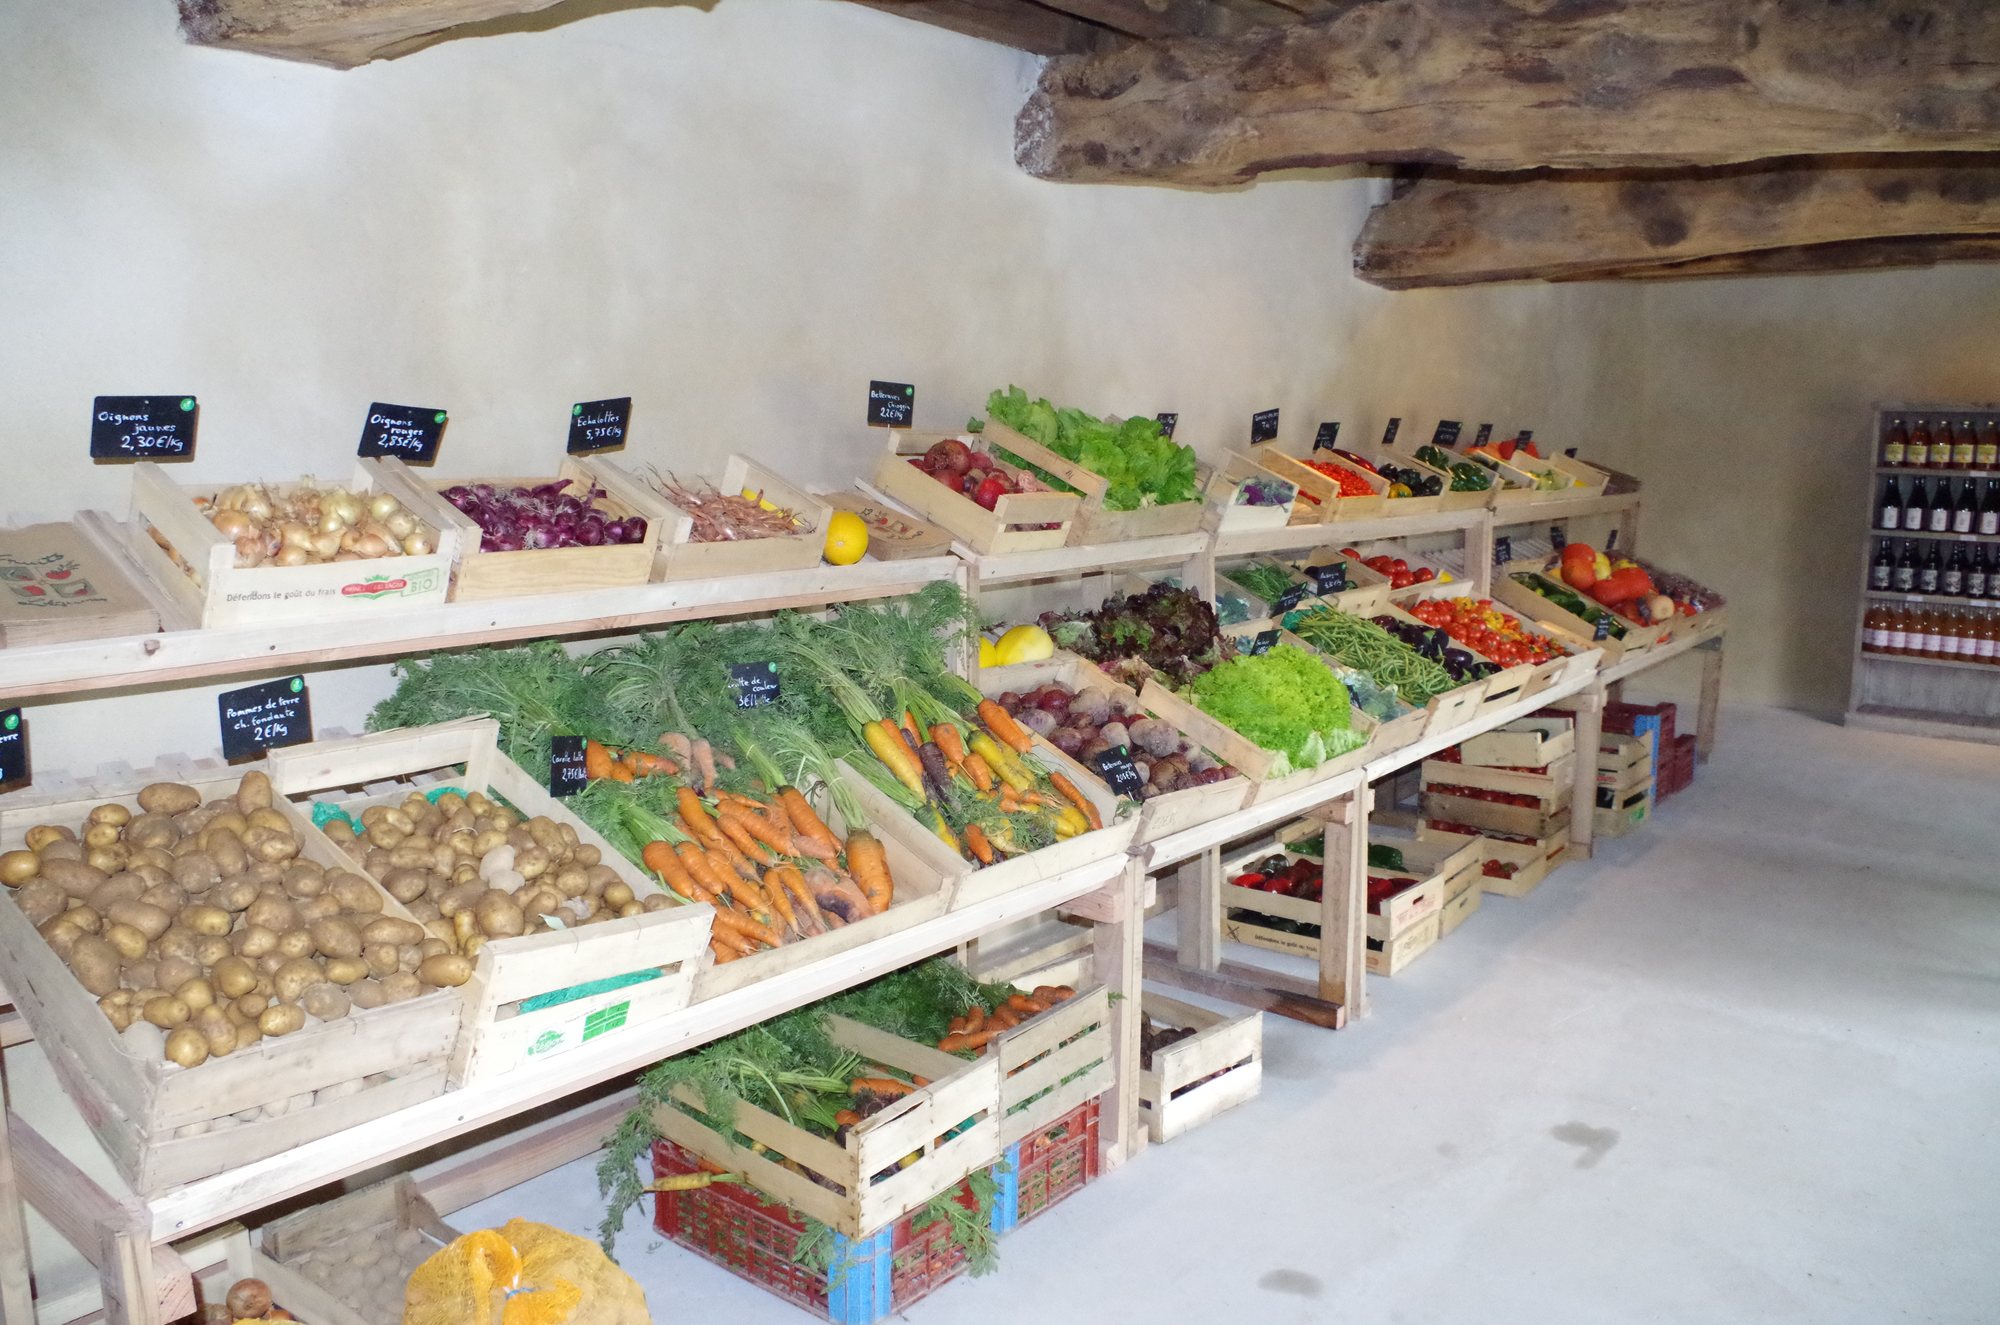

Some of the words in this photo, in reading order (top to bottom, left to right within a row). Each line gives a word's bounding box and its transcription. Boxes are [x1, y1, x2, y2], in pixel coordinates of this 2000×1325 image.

[98, 411, 149, 426] Oignons
[370, 414, 413, 429] Oignons
[131, 424, 177, 436] jaunes
[391, 428, 424, 439] rouges
[411, 578, 433, 593] BIO
[227, 704, 263, 719] Pommes
[265, 698, 278, 709] de
[279, 697, 300, 707] terre
